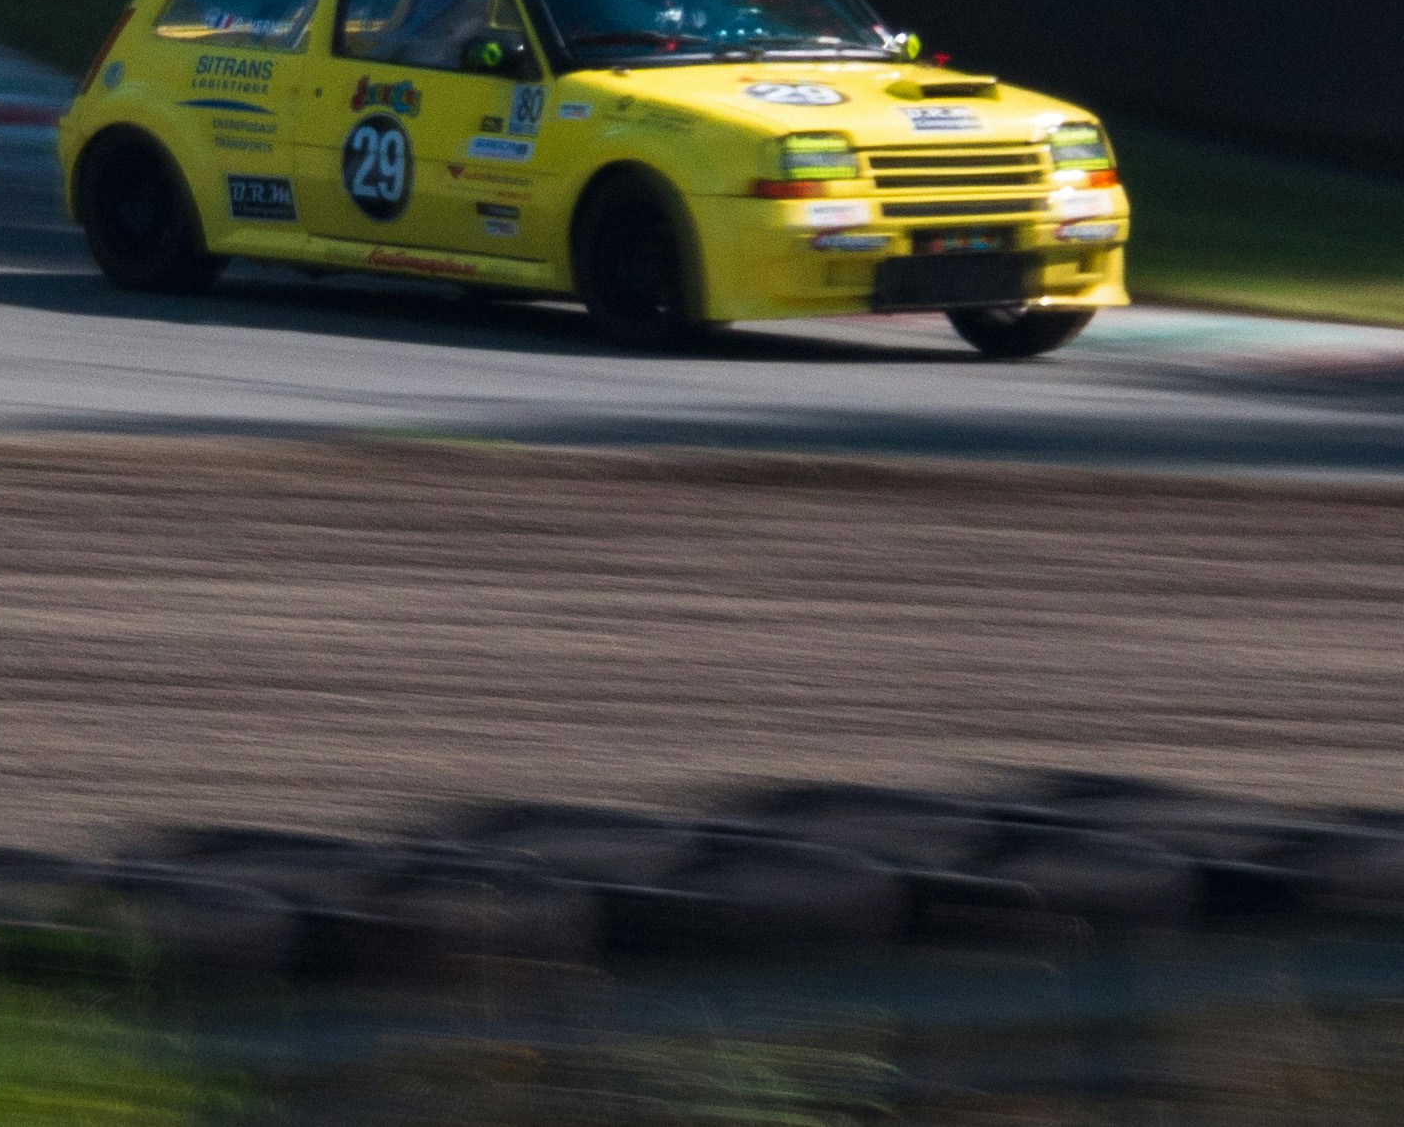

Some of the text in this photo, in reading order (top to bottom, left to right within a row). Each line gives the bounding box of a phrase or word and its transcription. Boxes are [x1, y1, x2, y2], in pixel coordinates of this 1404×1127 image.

[195, 54, 274, 81] SITRANS
[191, 78, 269, 95] LOGISTIQUE
[352, 126, 405, 201] 29
